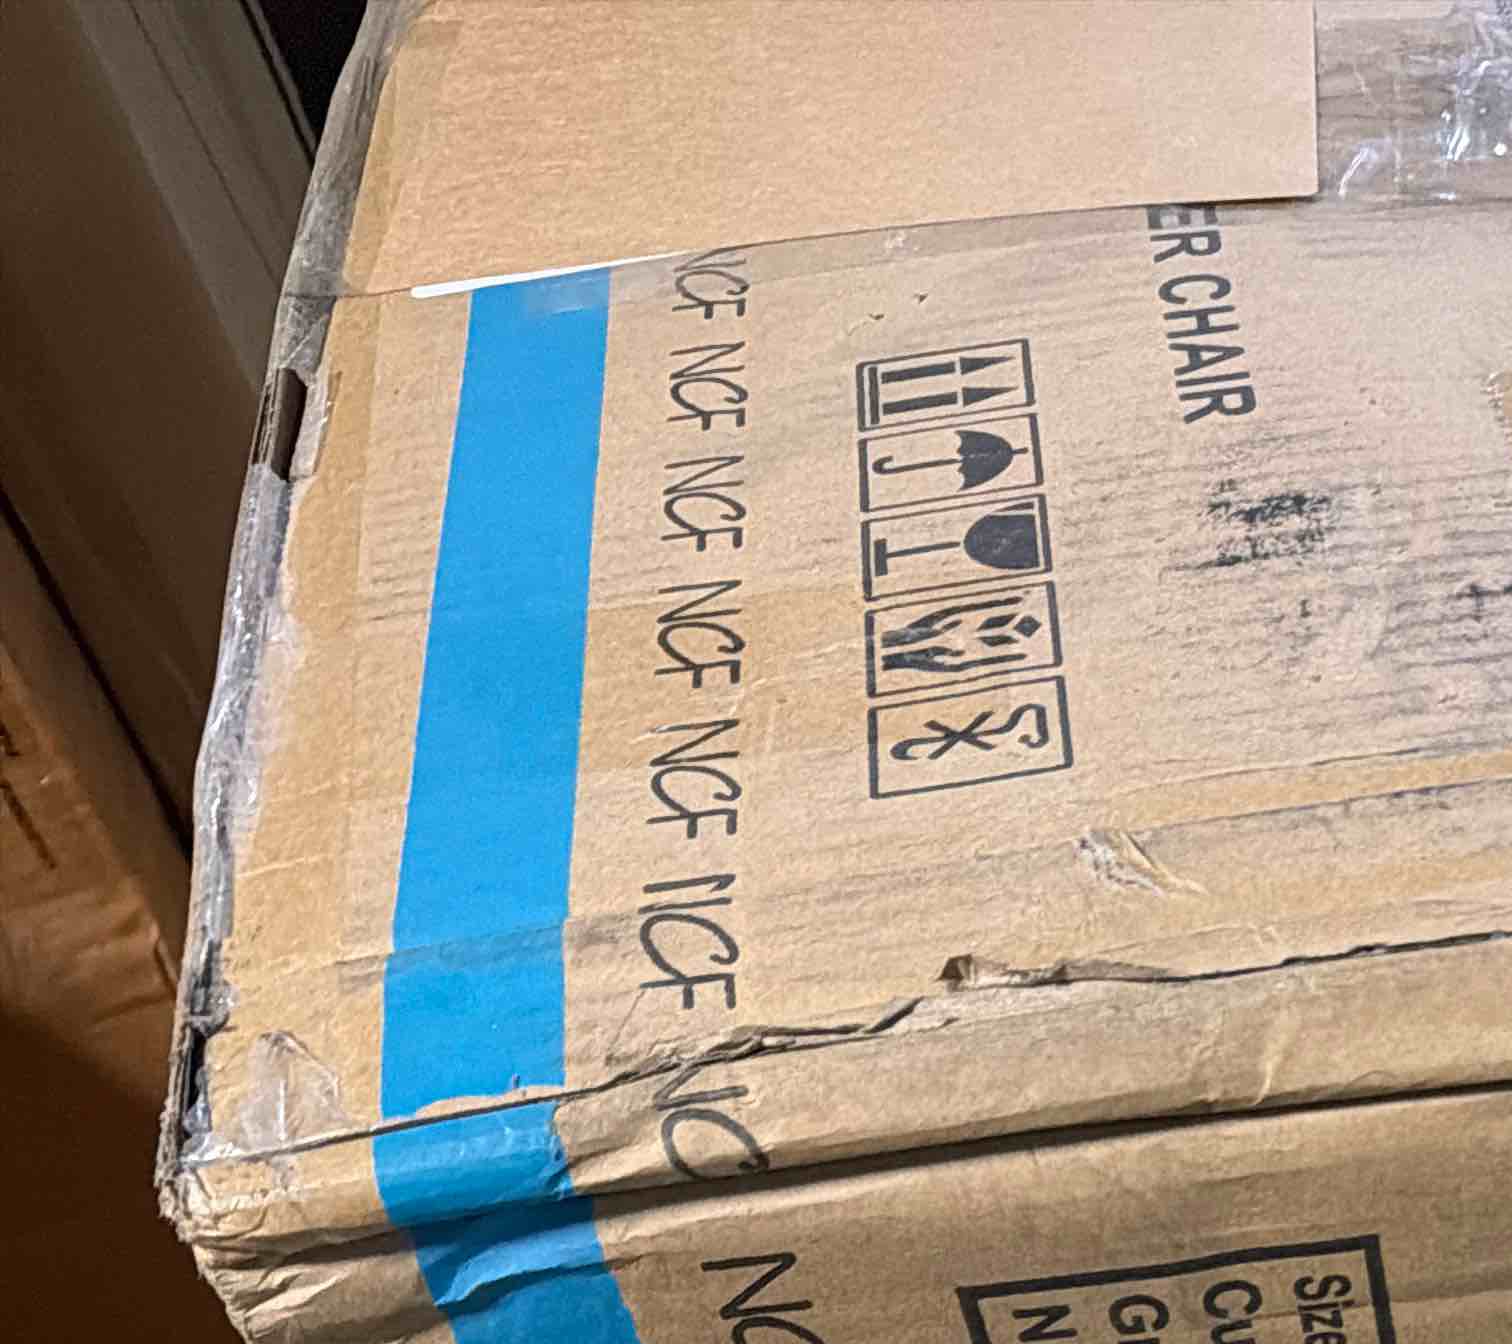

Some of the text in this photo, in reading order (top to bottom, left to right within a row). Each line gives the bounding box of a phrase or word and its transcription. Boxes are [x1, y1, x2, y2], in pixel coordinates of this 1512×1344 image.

[1158, 274, 1256, 424] CHAIR
[639, 250, 770, 1181] NCF NCF NCF NCF NCF NCF NC
